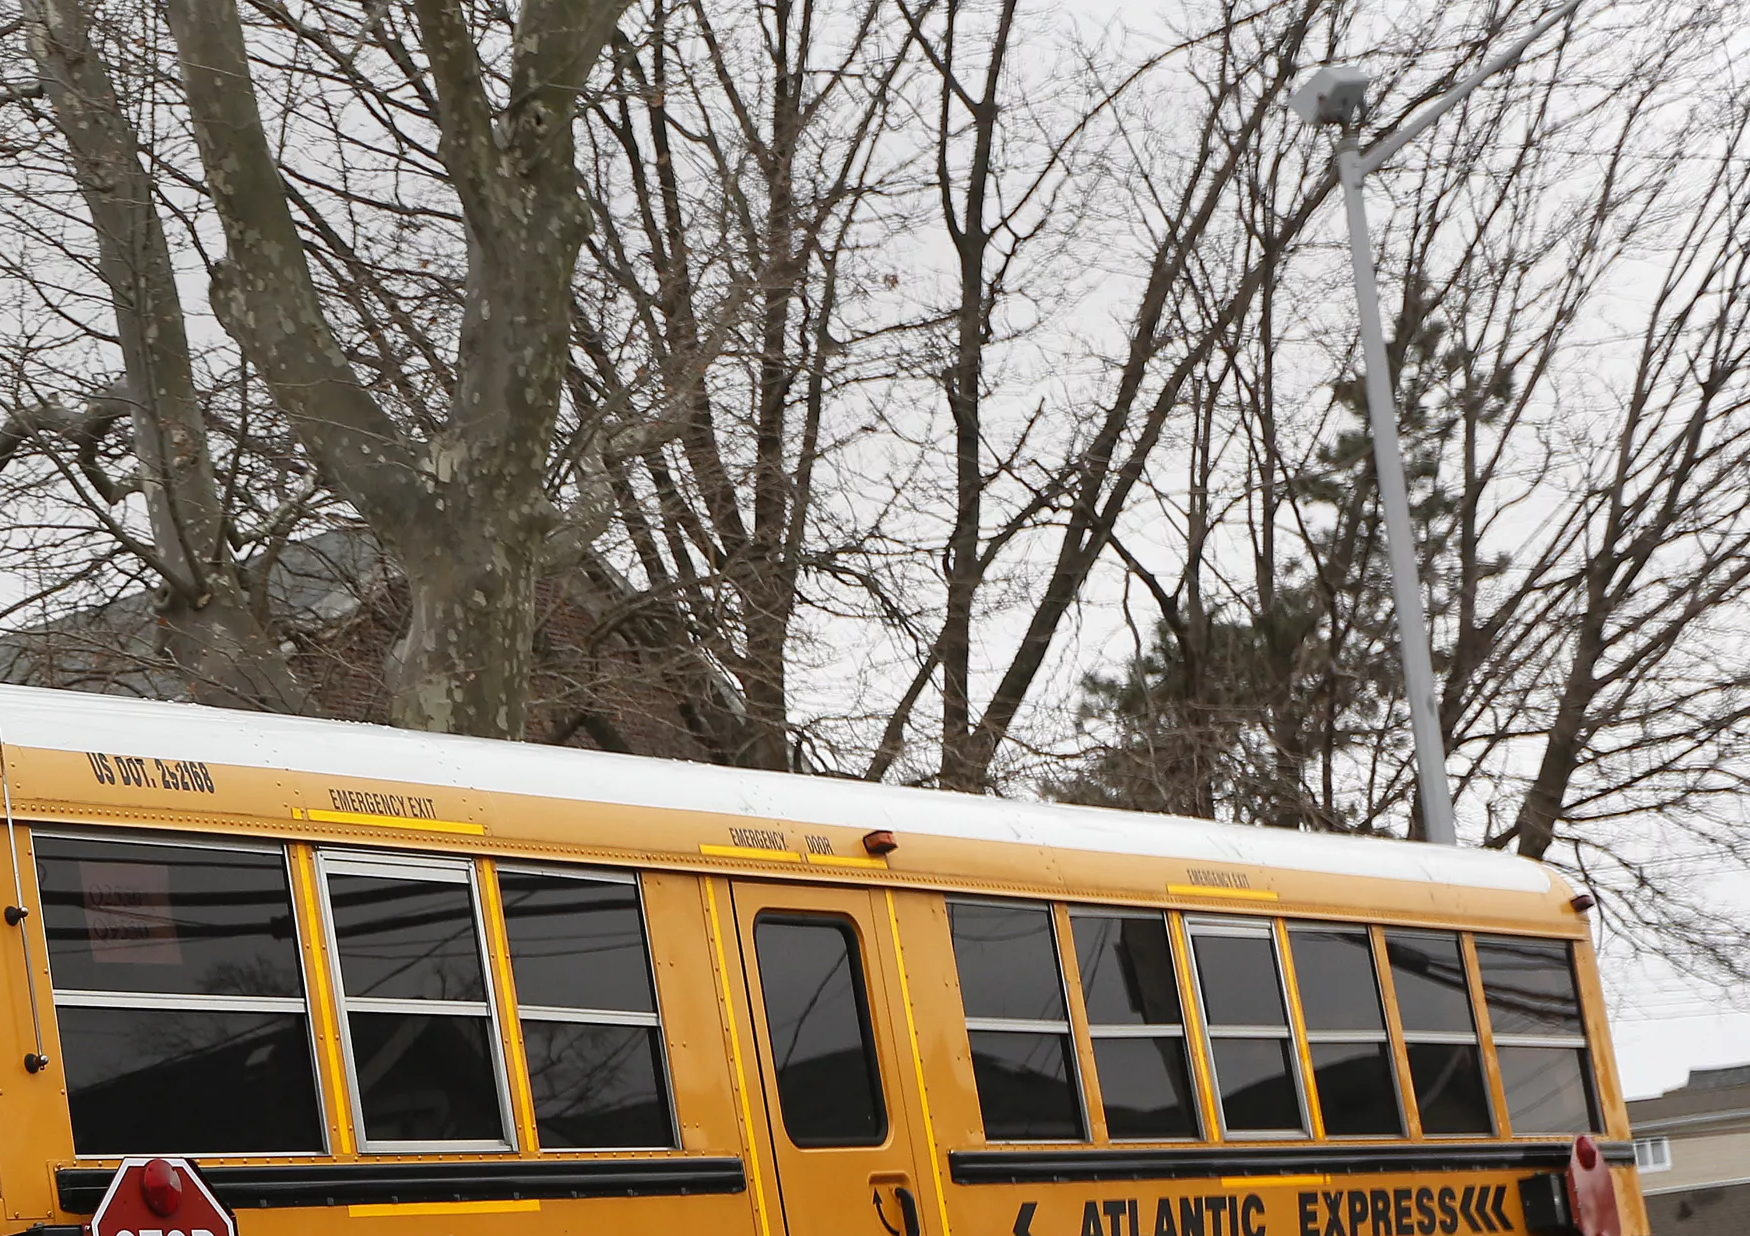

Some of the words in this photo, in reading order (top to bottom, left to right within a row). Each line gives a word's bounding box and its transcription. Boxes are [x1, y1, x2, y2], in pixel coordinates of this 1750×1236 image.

[86, 752, 116, 785] US
[114, 756, 157, 788] DOT.
[328, 788, 408, 817] EMERGENCY
[406, 796, 437, 819] EXIT
[729, 827, 787, 851] EMERGENCY
[804, 834, 835, 855] DOOR
